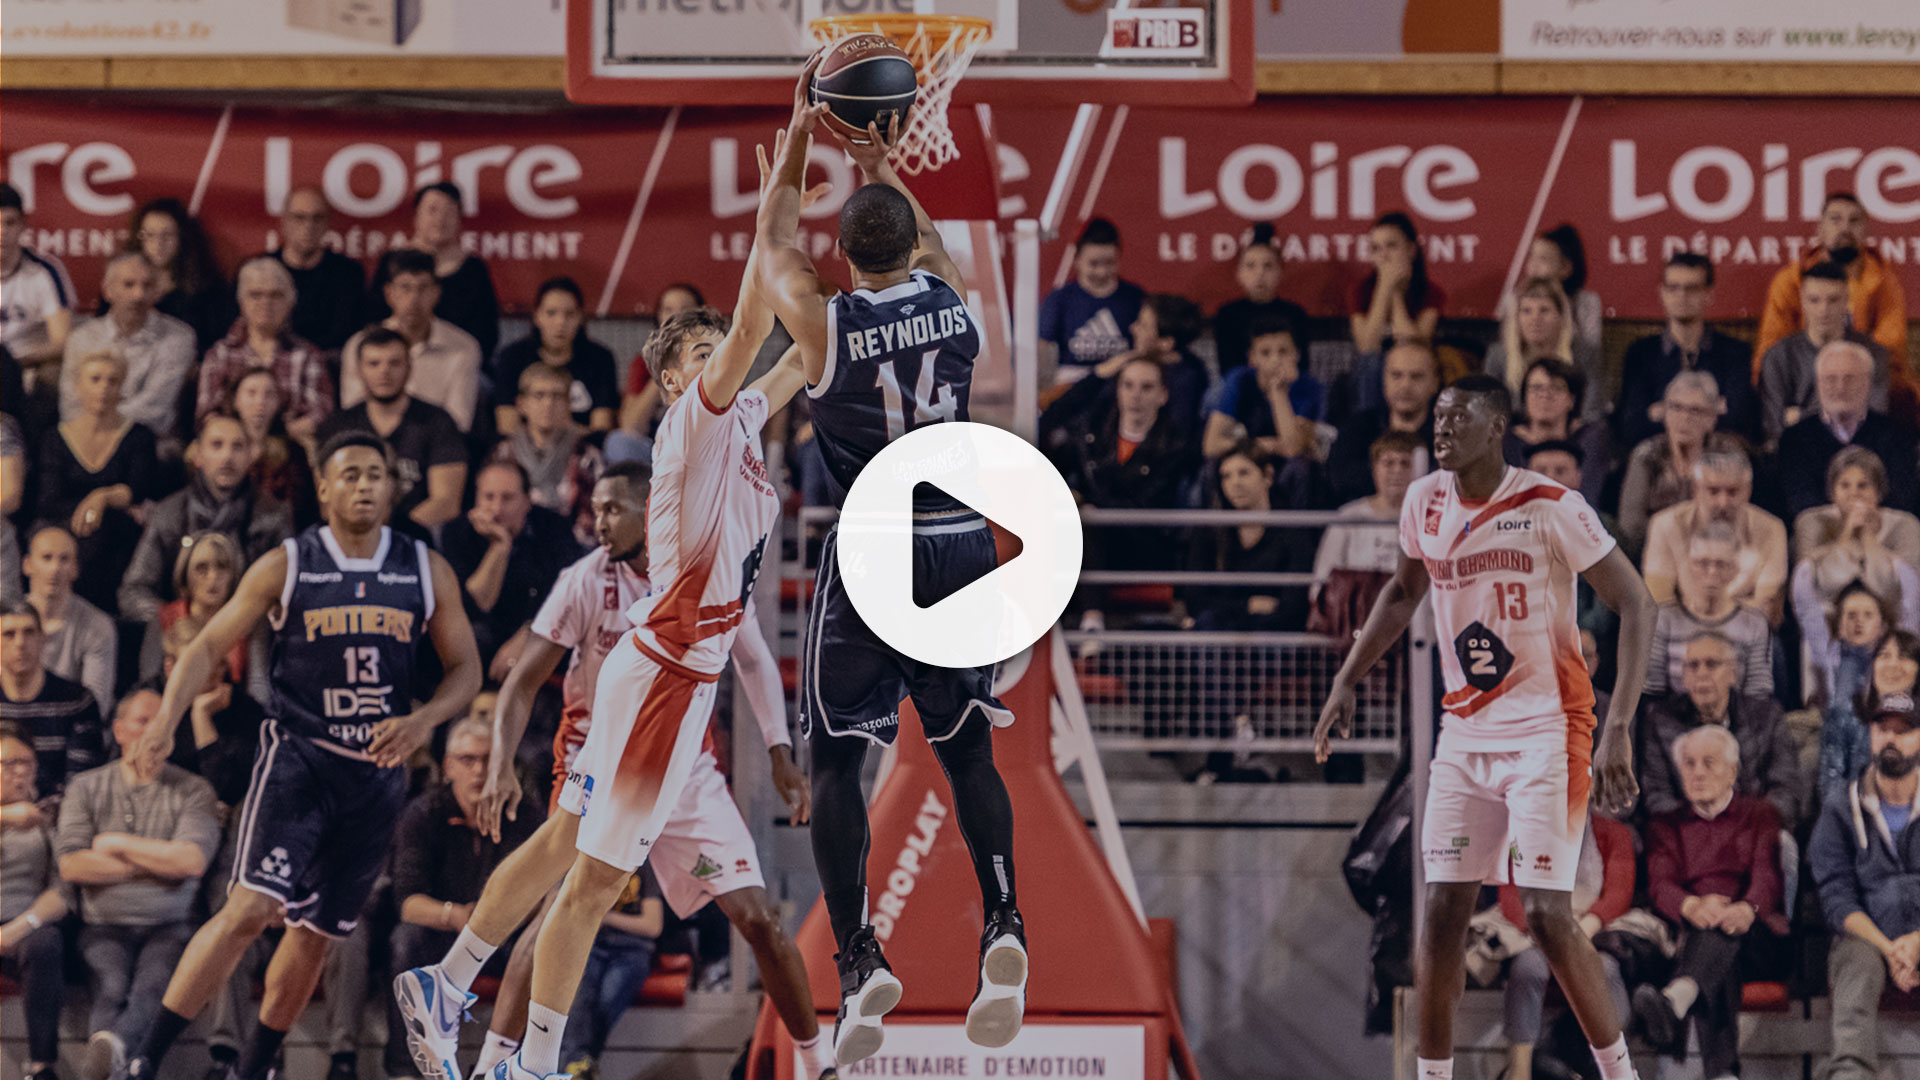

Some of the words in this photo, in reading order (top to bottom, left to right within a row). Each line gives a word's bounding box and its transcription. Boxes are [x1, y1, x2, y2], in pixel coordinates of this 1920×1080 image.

[1158, 136, 1480, 221] Loire
[1158, 233, 1197, 261] LE
[1608, 235, 1647, 264] LE
[847, 305, 967, 361] REYNOLDS
[874, 347, 958, 443] 14
[1497, 519, 1532, 532] Loire
[1456, 548, 1534, 578] CHAMOND
[1492, 581, 1529, 621] 13
[303, 604, 414, 643] POITIERS
[343, 646, 380, 684] 13
[985, 1056, 1106, 1077] D'EMOTION
